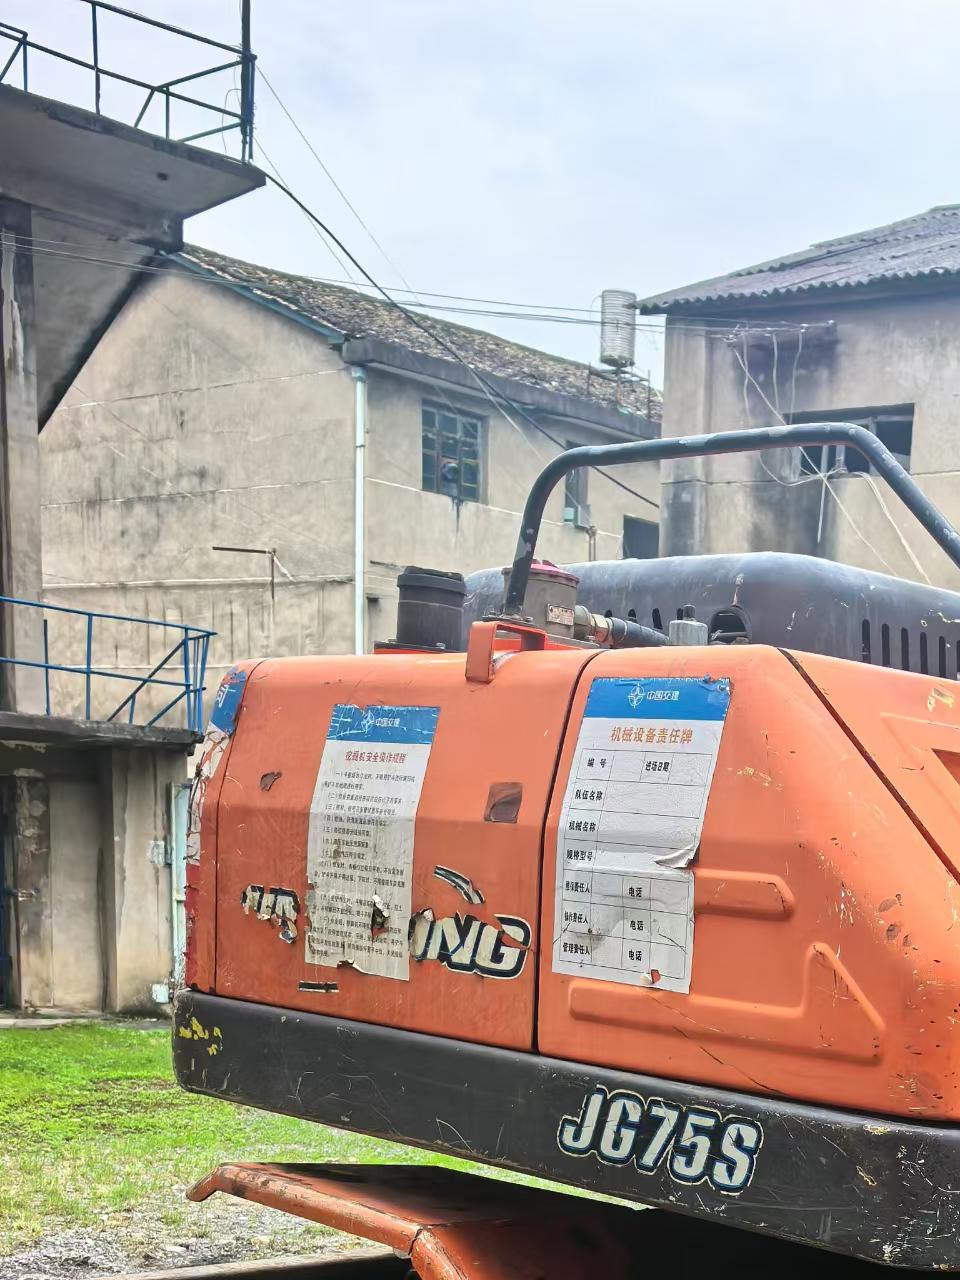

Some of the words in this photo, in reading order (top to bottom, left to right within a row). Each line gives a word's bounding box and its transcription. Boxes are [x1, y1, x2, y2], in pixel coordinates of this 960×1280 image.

[611, 726, 693, 744] 机械设备责任牌
[645, 760, 670, 772] 进场日期
[574, 789, 603, 801] 队伍名称
[568, 820, 596, 833] 机械名称
[566, 849, 593, 862] 规格型号
[628, 887, 643, 898] 电话
[629, 920, 644, 931] 电话
[562, 942, 590, 956] 管理责任人
[627, 949, 643, 962] 电话
[557, 1085, 764, 1195] JG75S
